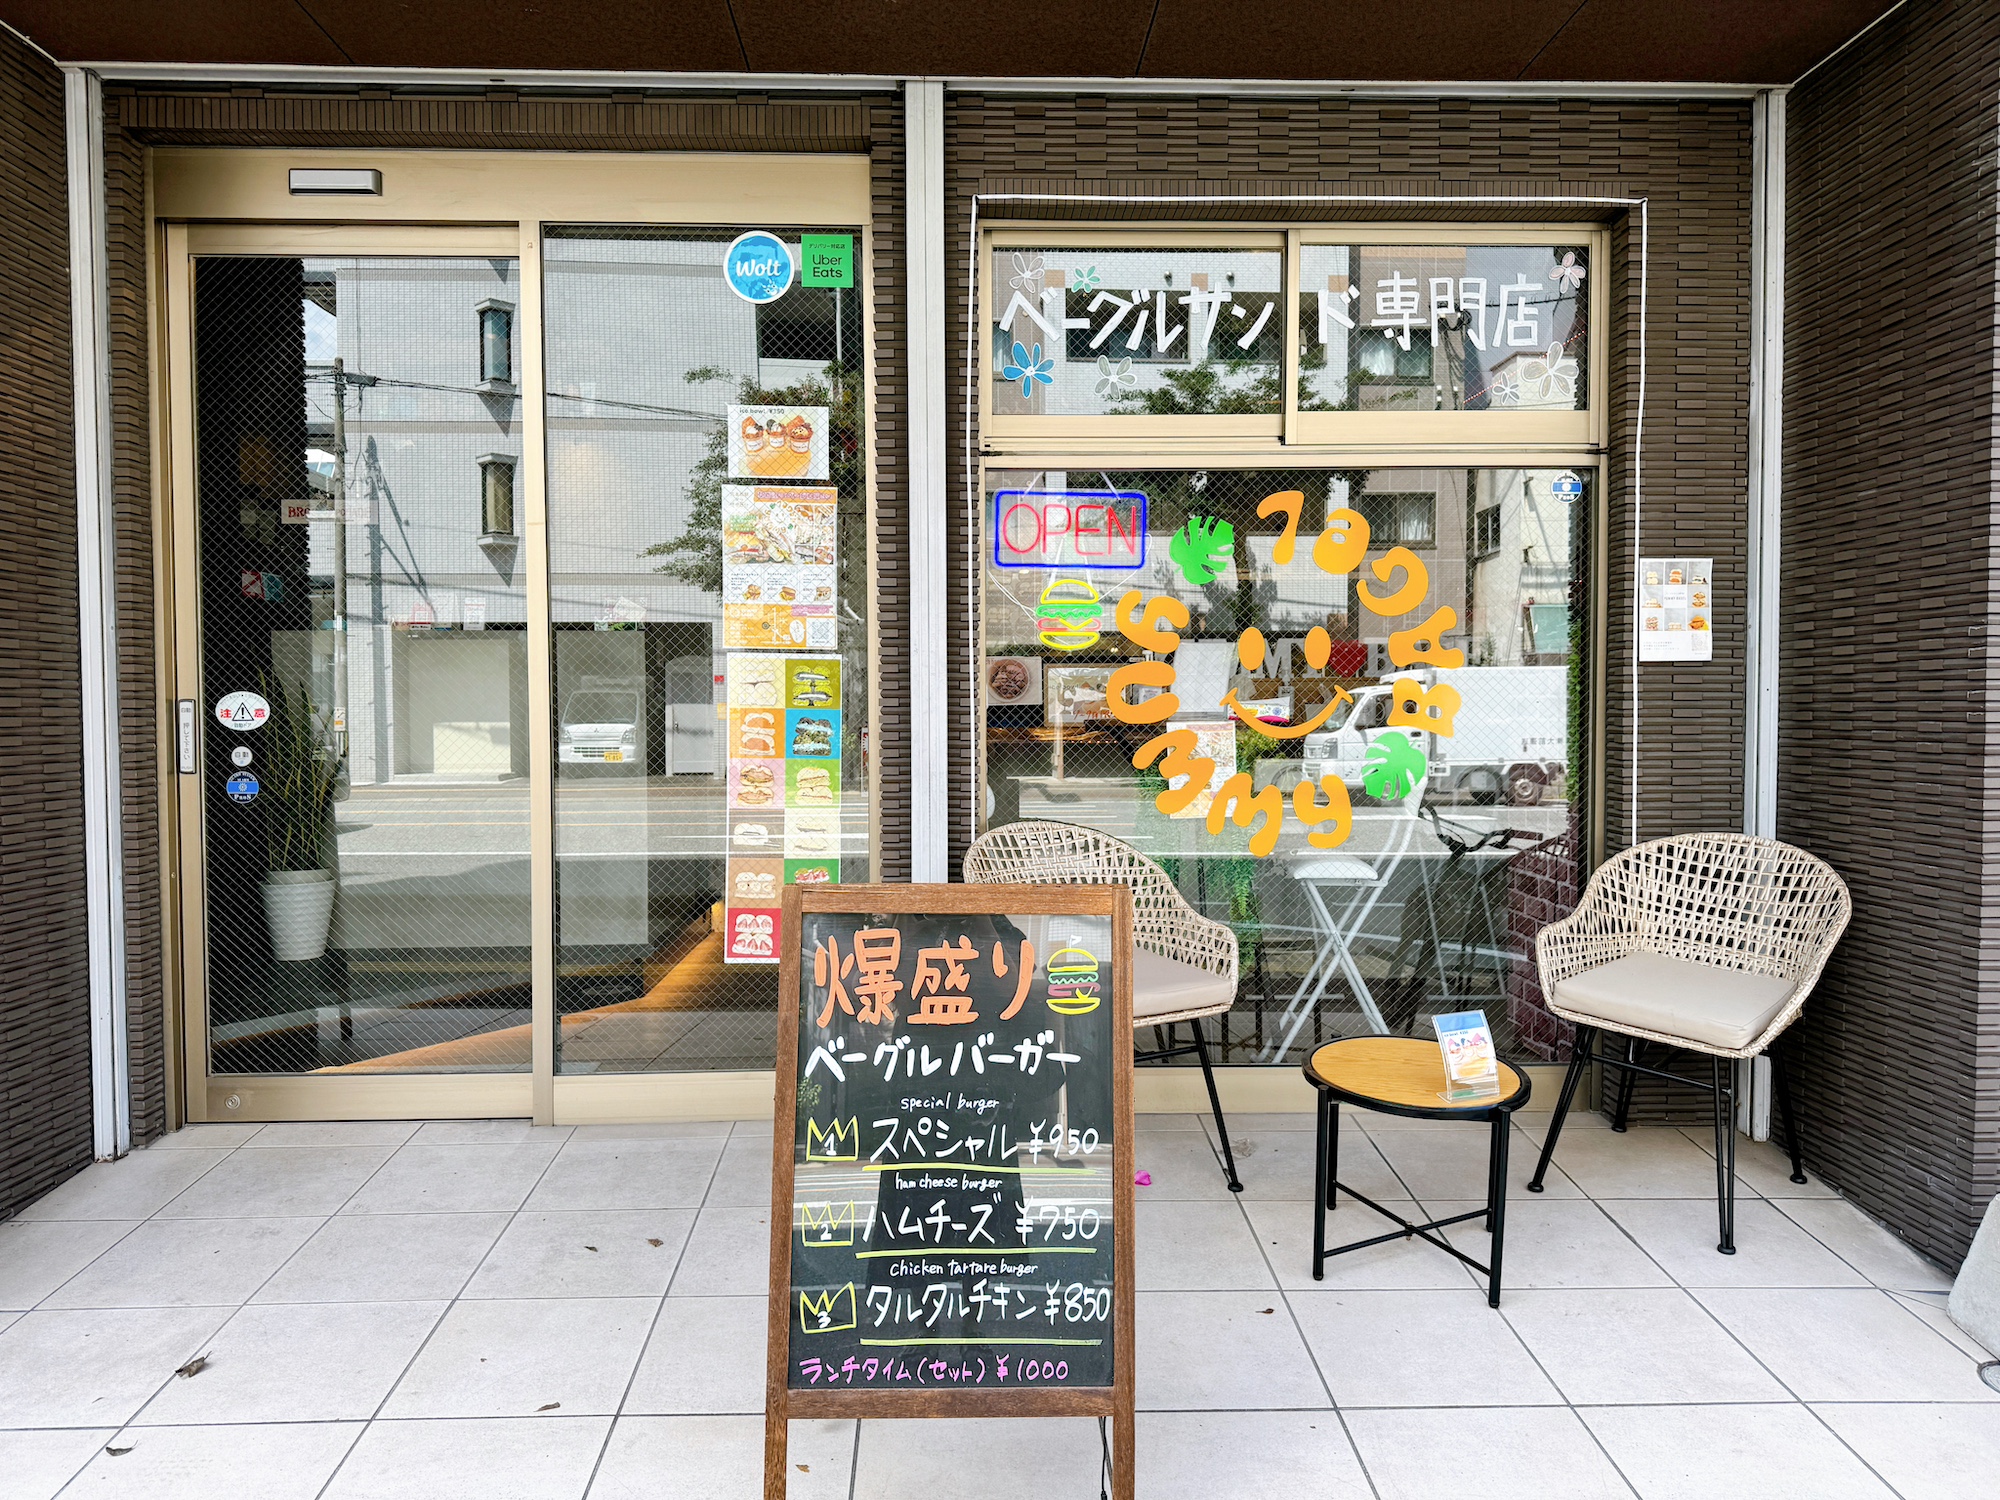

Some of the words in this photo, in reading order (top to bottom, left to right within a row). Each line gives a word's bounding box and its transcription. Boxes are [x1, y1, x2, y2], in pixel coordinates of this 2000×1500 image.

[735, 259, 782, 277] Wolt
[812, 254, 843, 266] Uber
[812, 267, 843, 278] Eats
[998, 269, 1544, 353] ベーグルサンド専門店
[1002, 503, 1137, 556] OPEN
[814, 928, 1036, 1029] 爆盛り
[804, 1029, 1082, 1082] ベーグルバーガー
[900, 1092, 952, 1113] special
[957, 1093, 1000, 1115] burger
[824, 1133, 838, 1155] 1
[869, 1117, 1019, 1163] スペシャル
[1029, 1118, 1100, 1165] ¥950
[895, 1172, 916, 1189] ham
[918, 1173, 958, 1189] cheese
[961, 1174, 1003, 1191] burger
[862, 1191, 1003, 1244] ハムチーズ
[1015, 1195, 1101, 1245] ¥750
[820, 1223, 832, 1241] 2
[947, 1260, 997, 1276] tartare
[1000, 1261, 1039, 1276] burger
[865, 1278, 1037, 1328] タルタルチキン
[1044, 1279, 1111, 1326] ¥850
[818, 1310, 831, 1329] 3
